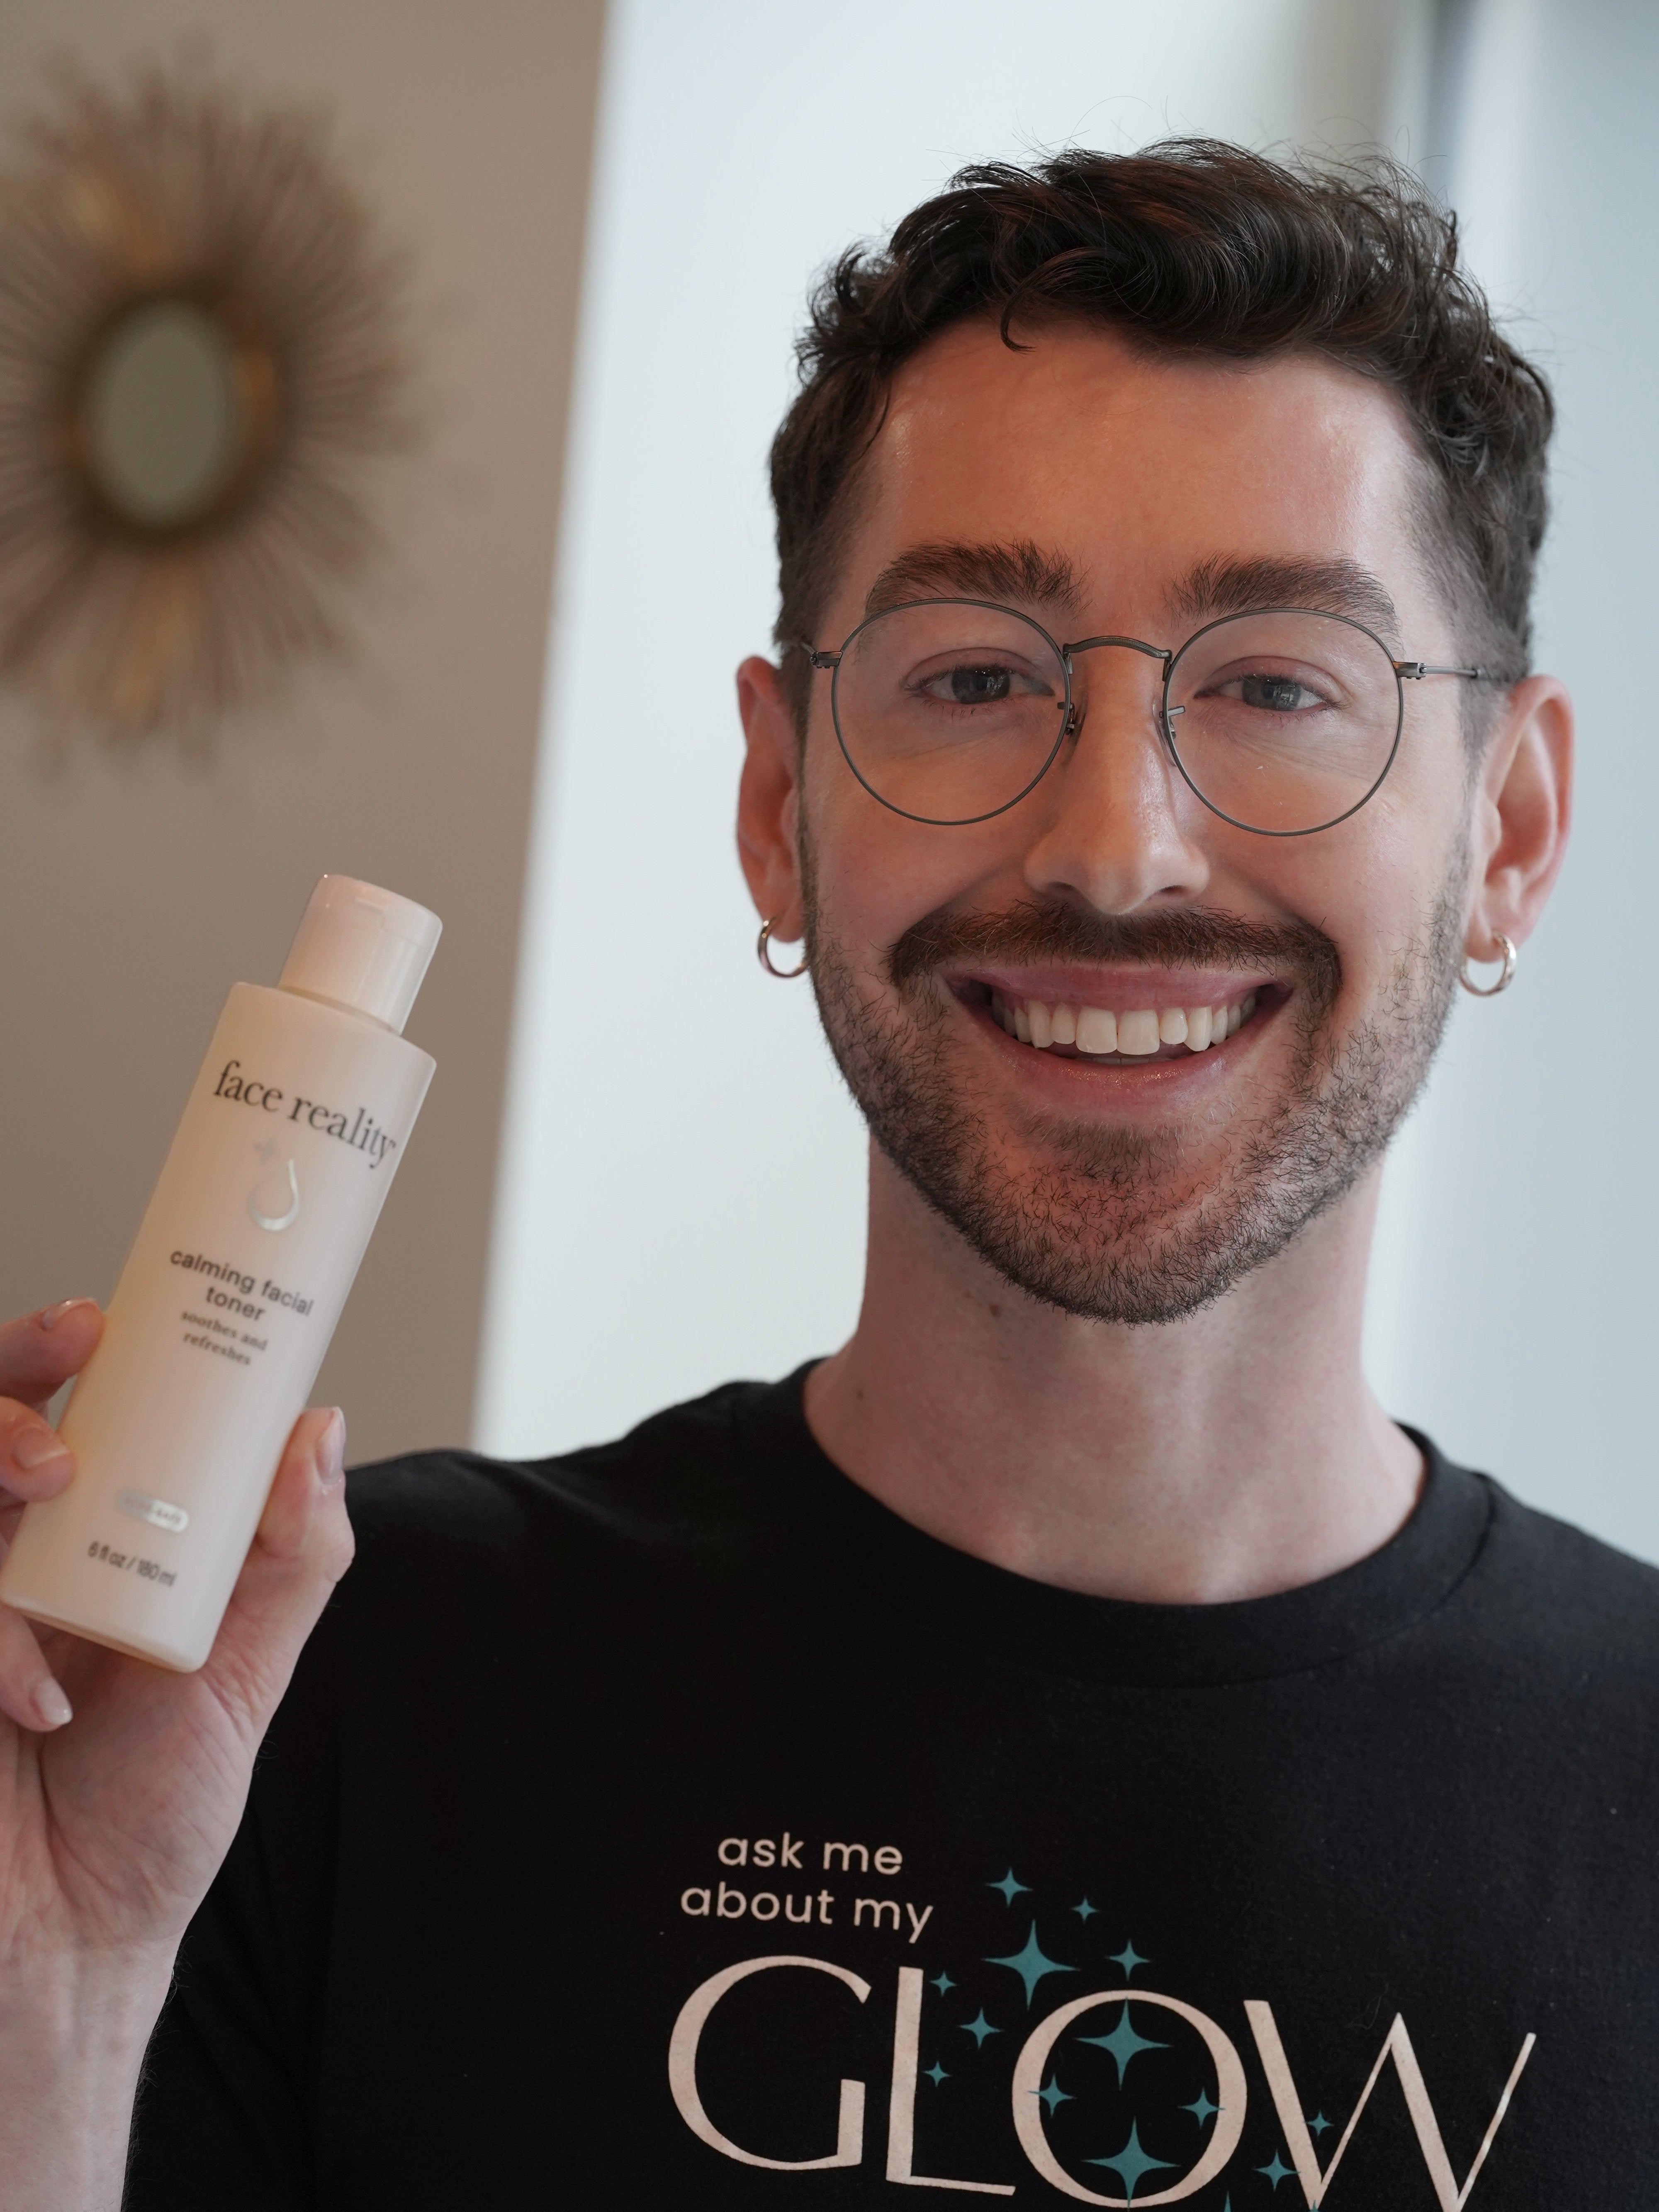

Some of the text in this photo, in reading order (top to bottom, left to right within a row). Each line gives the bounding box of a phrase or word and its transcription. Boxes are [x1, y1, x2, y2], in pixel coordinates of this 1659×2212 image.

[213, 1060, 397, 1169] face reality
[170, 1250, 314, 1316] calming facial
[205, 1286, 265, 1322] toner
[181, 1310, 268, 1351] soothes and
[182, 1332, 251, 1365] refreshes
[88, 1540, 100, 1558] 6
[108, 1552, 126, 1568] oz
[136, 1558, 160, 1581] 180
[718, 1832, 903, 1875] ask me
[681, 1881, 934, 1944] about my
[668, 1955, 1535, 2212] GLOW
